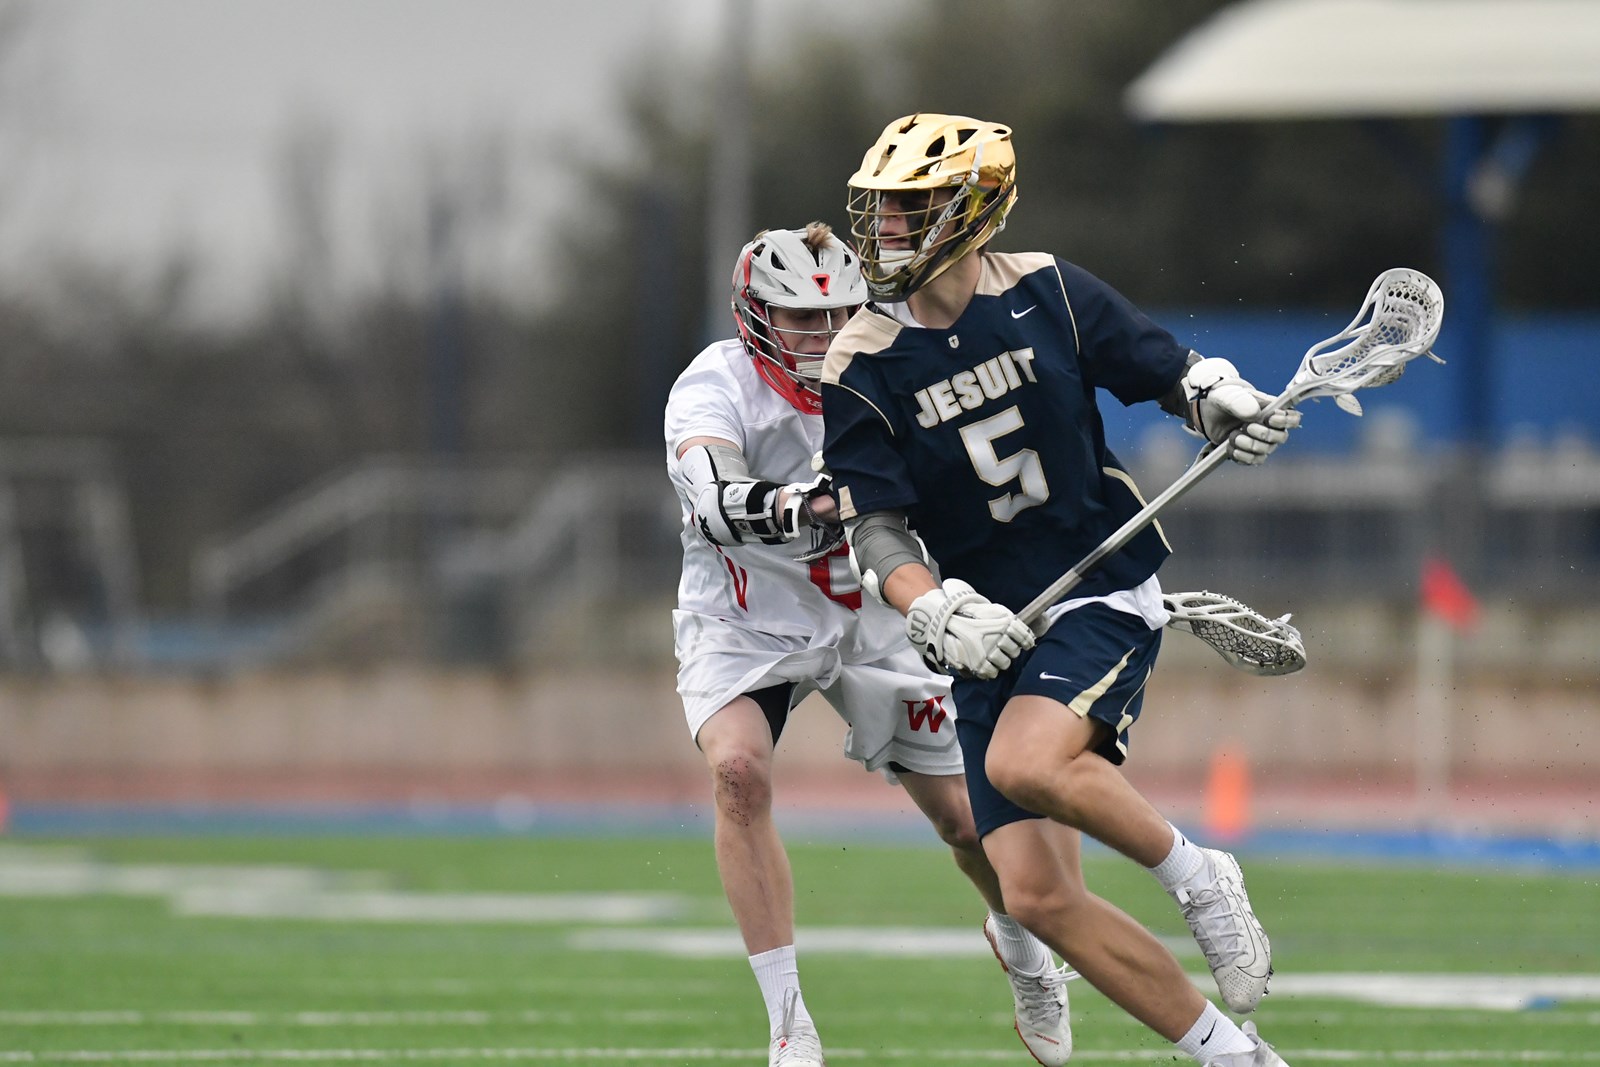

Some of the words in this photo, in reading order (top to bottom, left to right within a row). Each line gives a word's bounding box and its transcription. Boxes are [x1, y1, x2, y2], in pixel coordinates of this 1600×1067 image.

[914, 347, 1038, 429] JESUIT
[958, 404, 1050, 523] 5
[902, 694, 946, 733] W
